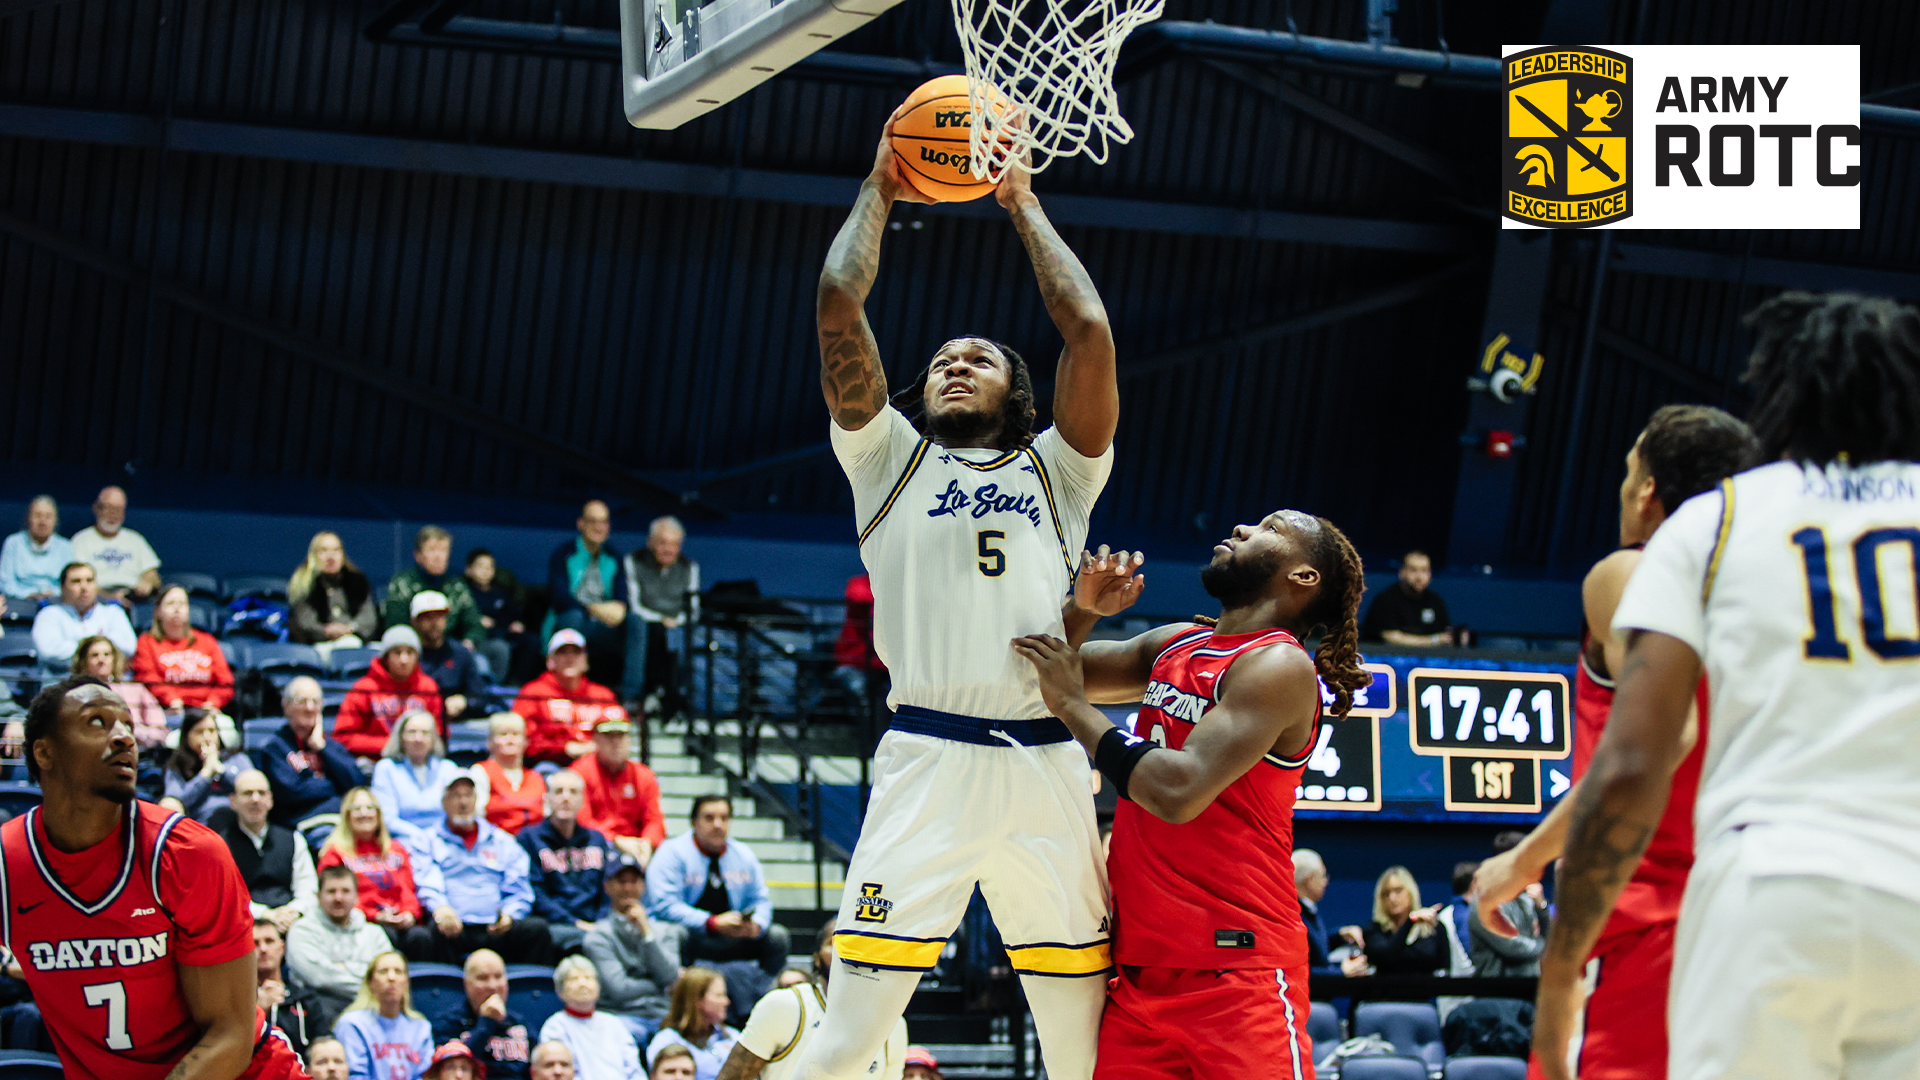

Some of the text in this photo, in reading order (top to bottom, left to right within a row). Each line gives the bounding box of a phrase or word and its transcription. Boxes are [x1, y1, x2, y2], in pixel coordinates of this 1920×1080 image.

[927, 478, 972, 518] La
[977, 530, 1006, 577] 5
[1788, 524, 1920, 666] 10
[1142, 679, 1209, 725] DAYTON
[1420, 683, 1555, 744] 17:41
[1470, 760, 1516, 800] 1ST
[28, 930, 169, 972] DAYTON
[1243, 936, 1248, 944] L
[81, 979, 135, 1051] 7
